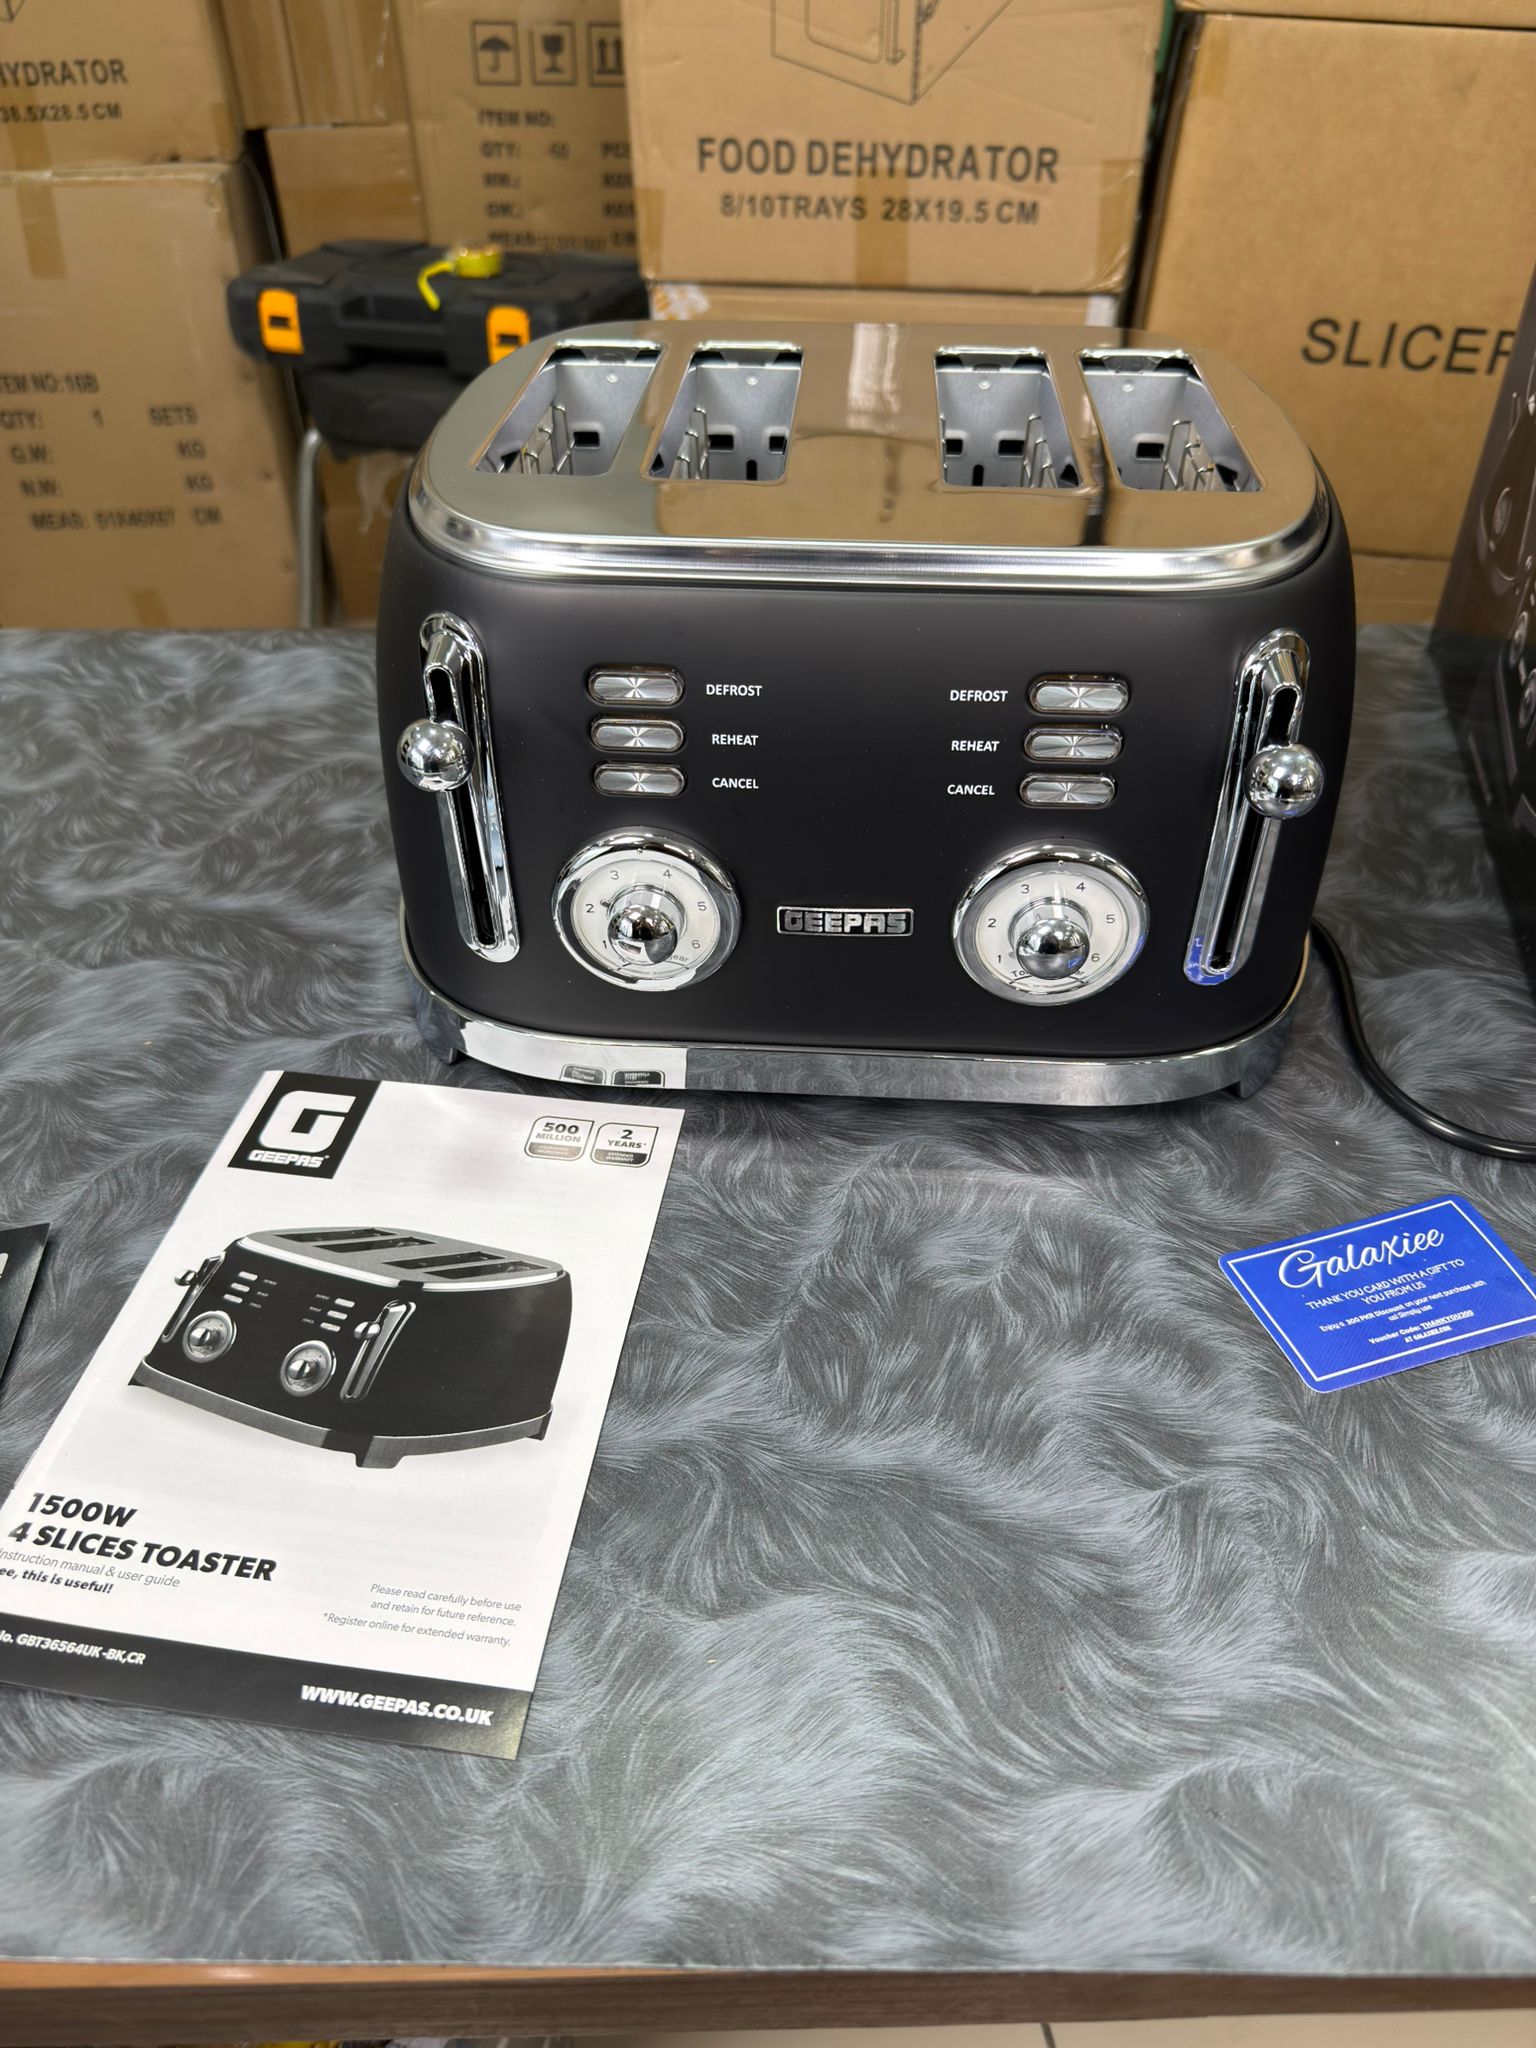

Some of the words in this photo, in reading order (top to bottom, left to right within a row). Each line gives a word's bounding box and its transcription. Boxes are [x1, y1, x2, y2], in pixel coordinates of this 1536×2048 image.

[697, 137, 795, 176] FOOD
[807, 140, 1060, 184] DEHYDRATOR
[720, 193, 867, 220] 8/10TRAYS
[881, 198, 989, 224] 28X19.5
[996, 200, 1039, 225] CM
[177, 440, 207, 459] KG
[705, 684, 762, 697] DEFROST
[949, 690, 1008, 702] DEFROST
[711, 734, 759, 746] REHEAT
[951, 740, 1000, 752] REHEAT
[712, 778, 759, 789] CANCEL
[947, 785, 995, 796] CANCEL
[610, 870, 619, 880] 3
[663, 869, 672, 879] 4
[1020, 884, 1030, 894] 3
[1076, 882, 1086, 892] 4
[586, 904, 595, 913] 2
[697, 901, 707, 911] 5
[784, 910, 906, 933] GEEPAS
[987, 918, 997, 928] 2
[1106, 914, 1115, 924] 5
[691, 940, 701, 949] 6
[1091, 953, 1100, 962] 6
[258, 1090, 356, 1153] G
[543, 1122, 579, 1134] 500
[536, 1133, 581, 1143] MILLION
[621, 1129, 633, 1140] 2
[248, 1150, 325, 1168] GEEPAS
[1278, 1228, 1444, 1288] Galaxiee
[1305, 1294, 1343, 1309] THANK
[1340, 1288, 1365, 1300] YOU
[1363, 1281, 1390, 1294] CARD
[1388, 1272, 1420, 1286] WITH
[1419, 1270, 1428, 1278] A
[1426, 1263, 1448, 1275] GIFT
[1447, 1259, 1465, 1268] TO
[1361, 1293, 1385, 1305] YOU
[1384, 1284, 1414, 1298] FROM
[1411, 1281, 1426, 1290] US
[27, 1492, 138, 1528] 1500W
[8, 1522, 33, 1542] 4
[33, 1526, 138, 1560] SLICES
[141, 1542, 277, 1581] TOASTER
[60, 1560, 105, 1576] manual
[105, 1566, 116, 1578] &
[118, 1572, 144, 1582] user
[144, 1573, 181, 1588] guide
[22, 1569, 49, 1583] this
[50, 1573, 62, 1585] is
[64, 1579, 114, 1594] useful!
[370, 1583, 402, 1597] Please
[403, 1587, 426, 1600] read
[427, 1592, 469, 1606] carefully
[470, 1596, 502, 1610] before
[504, 1602, 522, 1612] use
[370, 1600, 390, 1611] and
[392, 1602, 419, 1614] retain
[421, 1605, 436, 1617] for
[437, 1607, 466, 1620] future
[467, 1611, 516, 1627] reference.
[369, 1619, 399, 1632] online
[401, 1622, 416, 1634] for
[417, 1625, 464, 1640] extended
[466, 1634, 511, 1648] warranty.
[301, 1685, 494, 1726] WWW.GEEPAS.CO.UK
